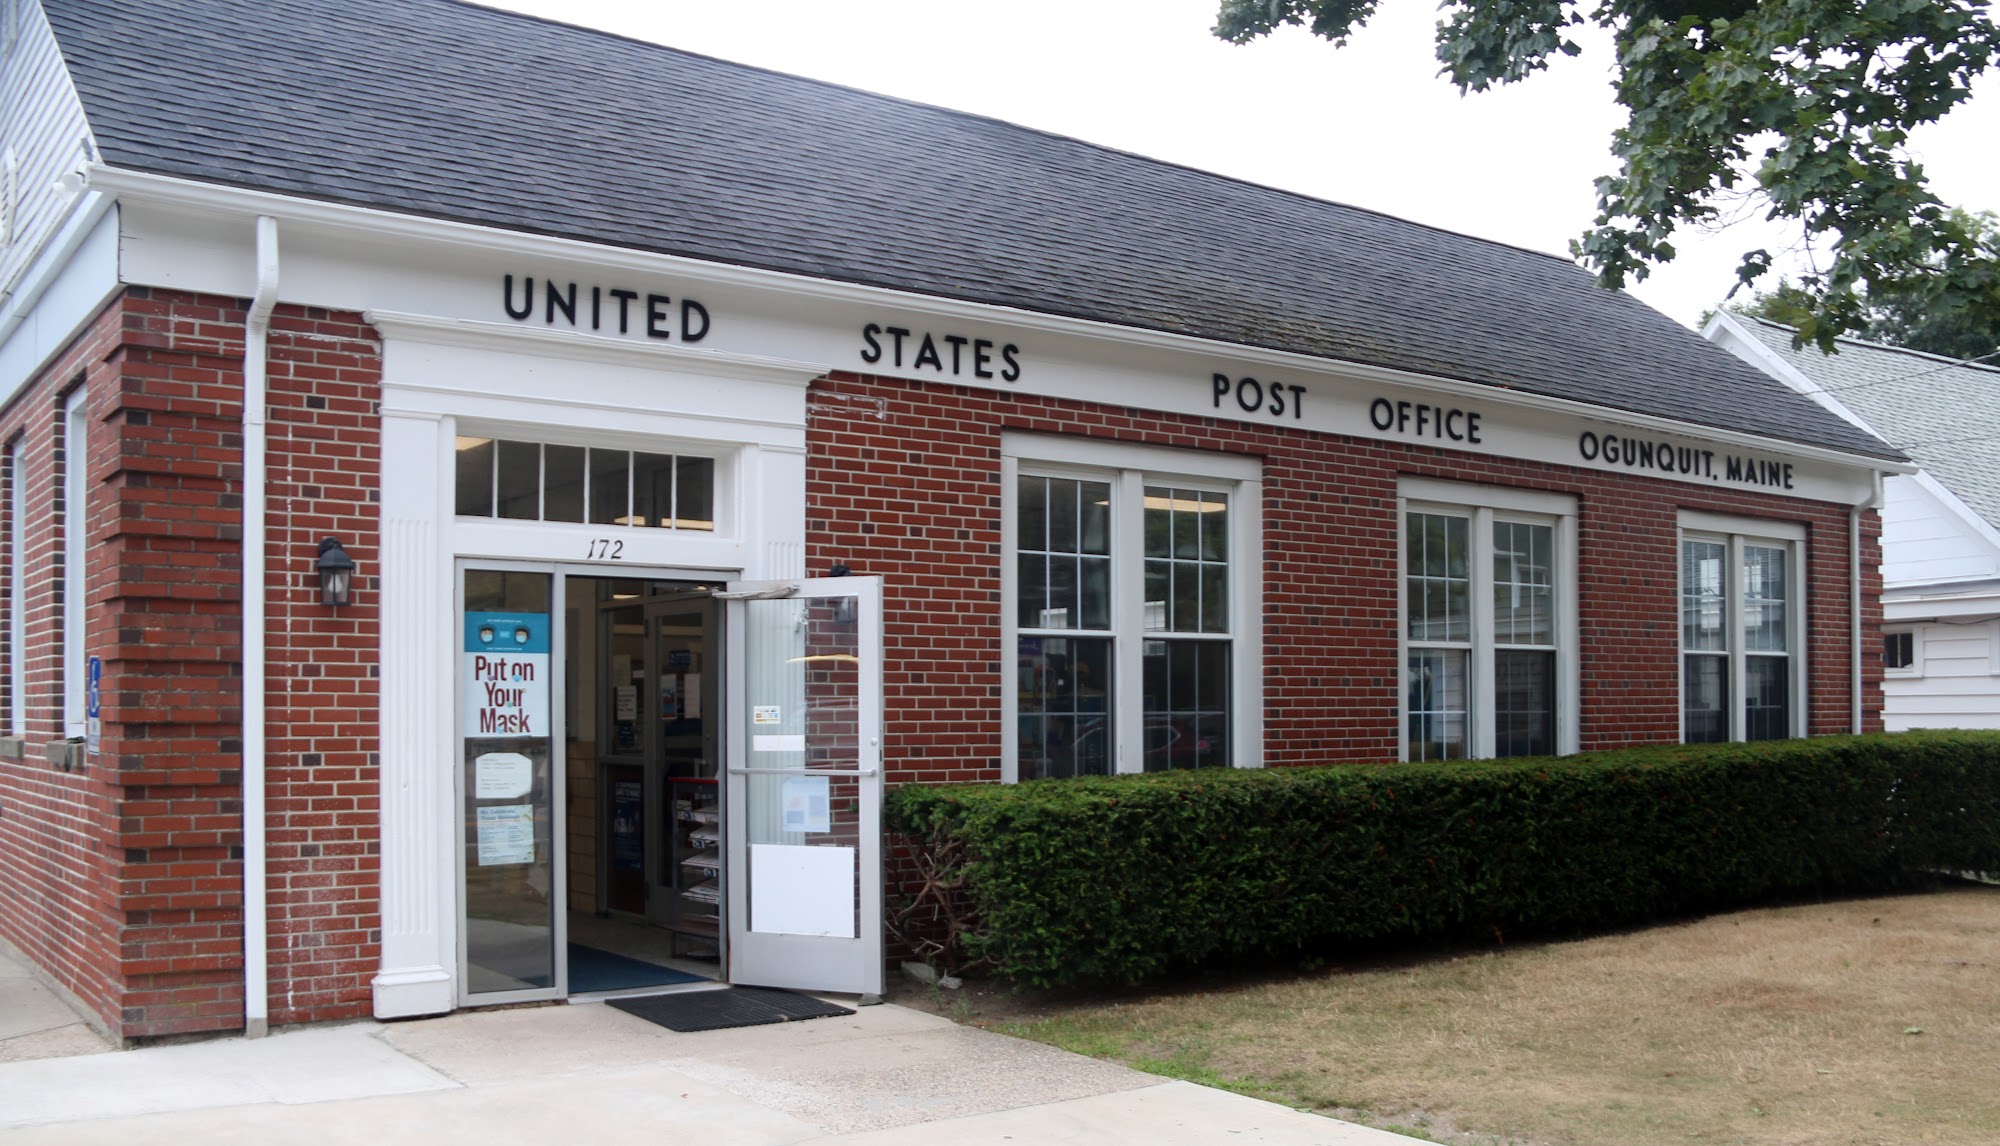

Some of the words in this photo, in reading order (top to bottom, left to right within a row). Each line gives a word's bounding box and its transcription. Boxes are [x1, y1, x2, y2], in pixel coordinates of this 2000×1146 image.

[504, 274, 710, 342] UNITED
[860, 323, 1021, 382] STATES
[1212, 373, 1307, 419] POST
[1370, 398, 1482, 444] OFFICE
[1726, 455, 1794, 489] MAINE
[587, 539, 623, 559] 172
[475, 655, 507, 682] Put
[512, 662, 534, 682] on
[484, 682, 526, 707] Your
[480, 708, 530, 733] Mask
